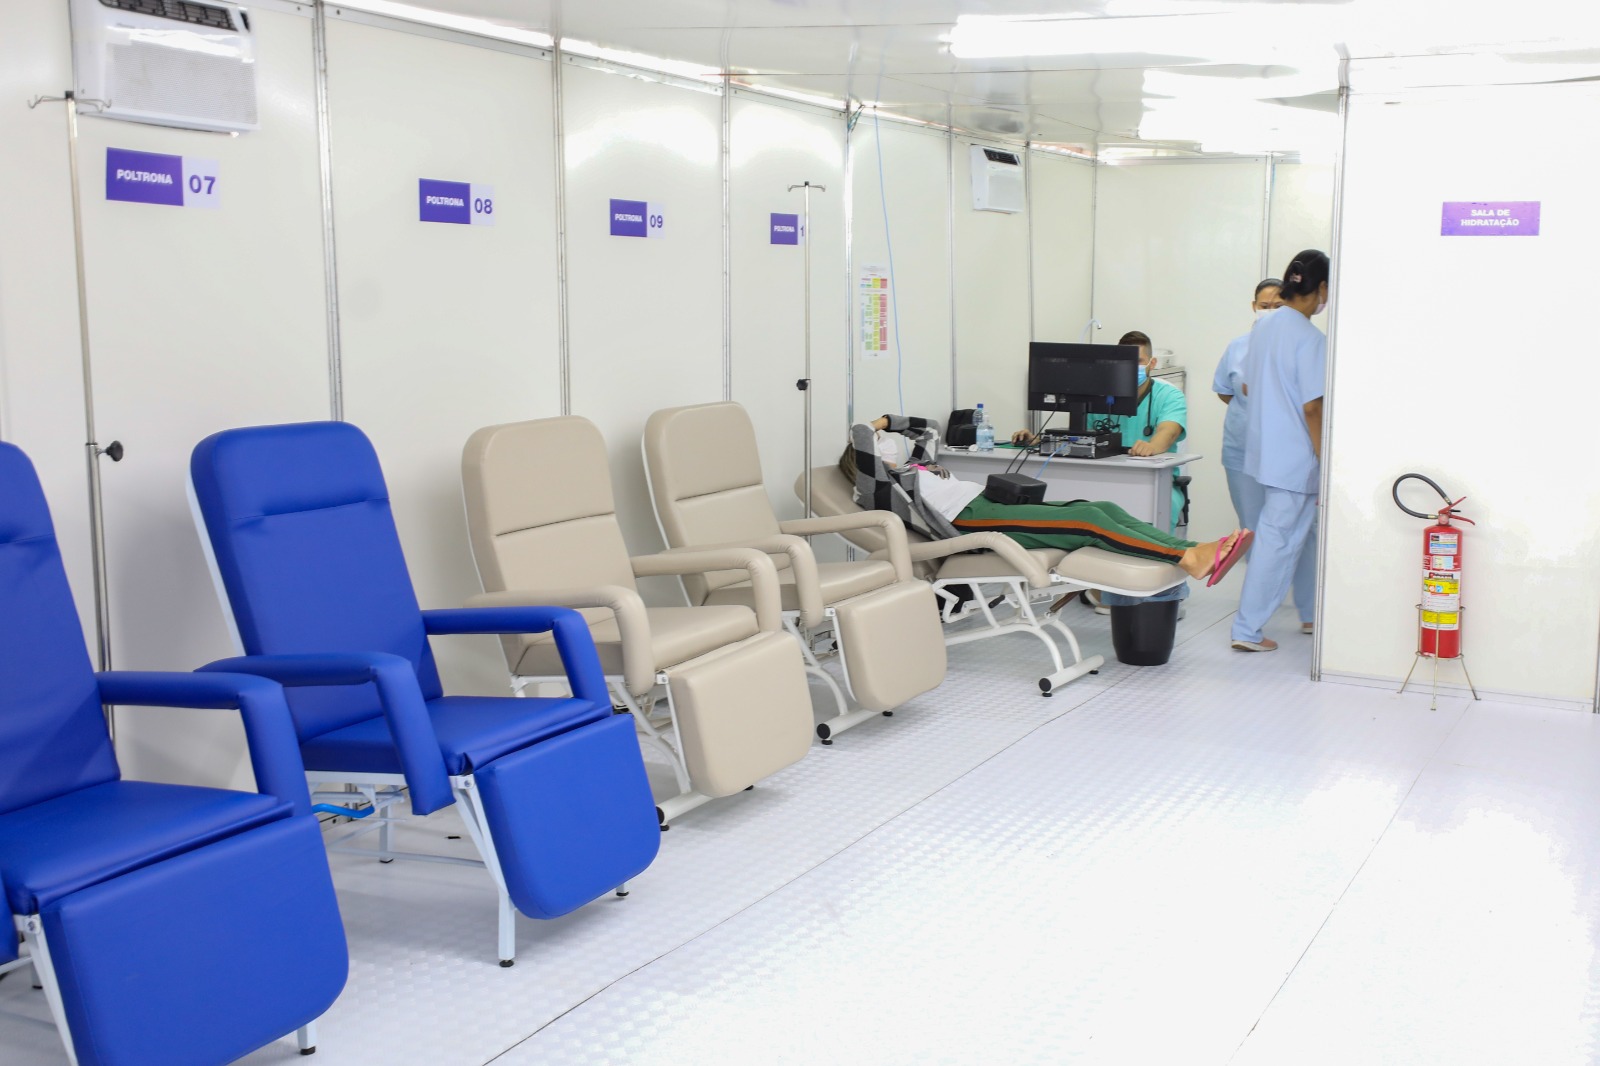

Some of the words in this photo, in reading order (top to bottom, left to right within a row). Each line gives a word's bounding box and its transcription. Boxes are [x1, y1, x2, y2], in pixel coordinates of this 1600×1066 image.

[117, 169, 173, 184] POLTRONA
[189, 174, 216, 195] 07
[426, 195, 464, 207] POLTRONA
[475, 197, 493, 214] 08
[615, 213, 643, 222] POLTRONA
[650, 214, 663, 229] 09
[1471, 209, 1495, 217] SALA
[1497, 209, 1511, 217] DE
[1461, 218, 1520, 228] HIDRATAÇÃO
